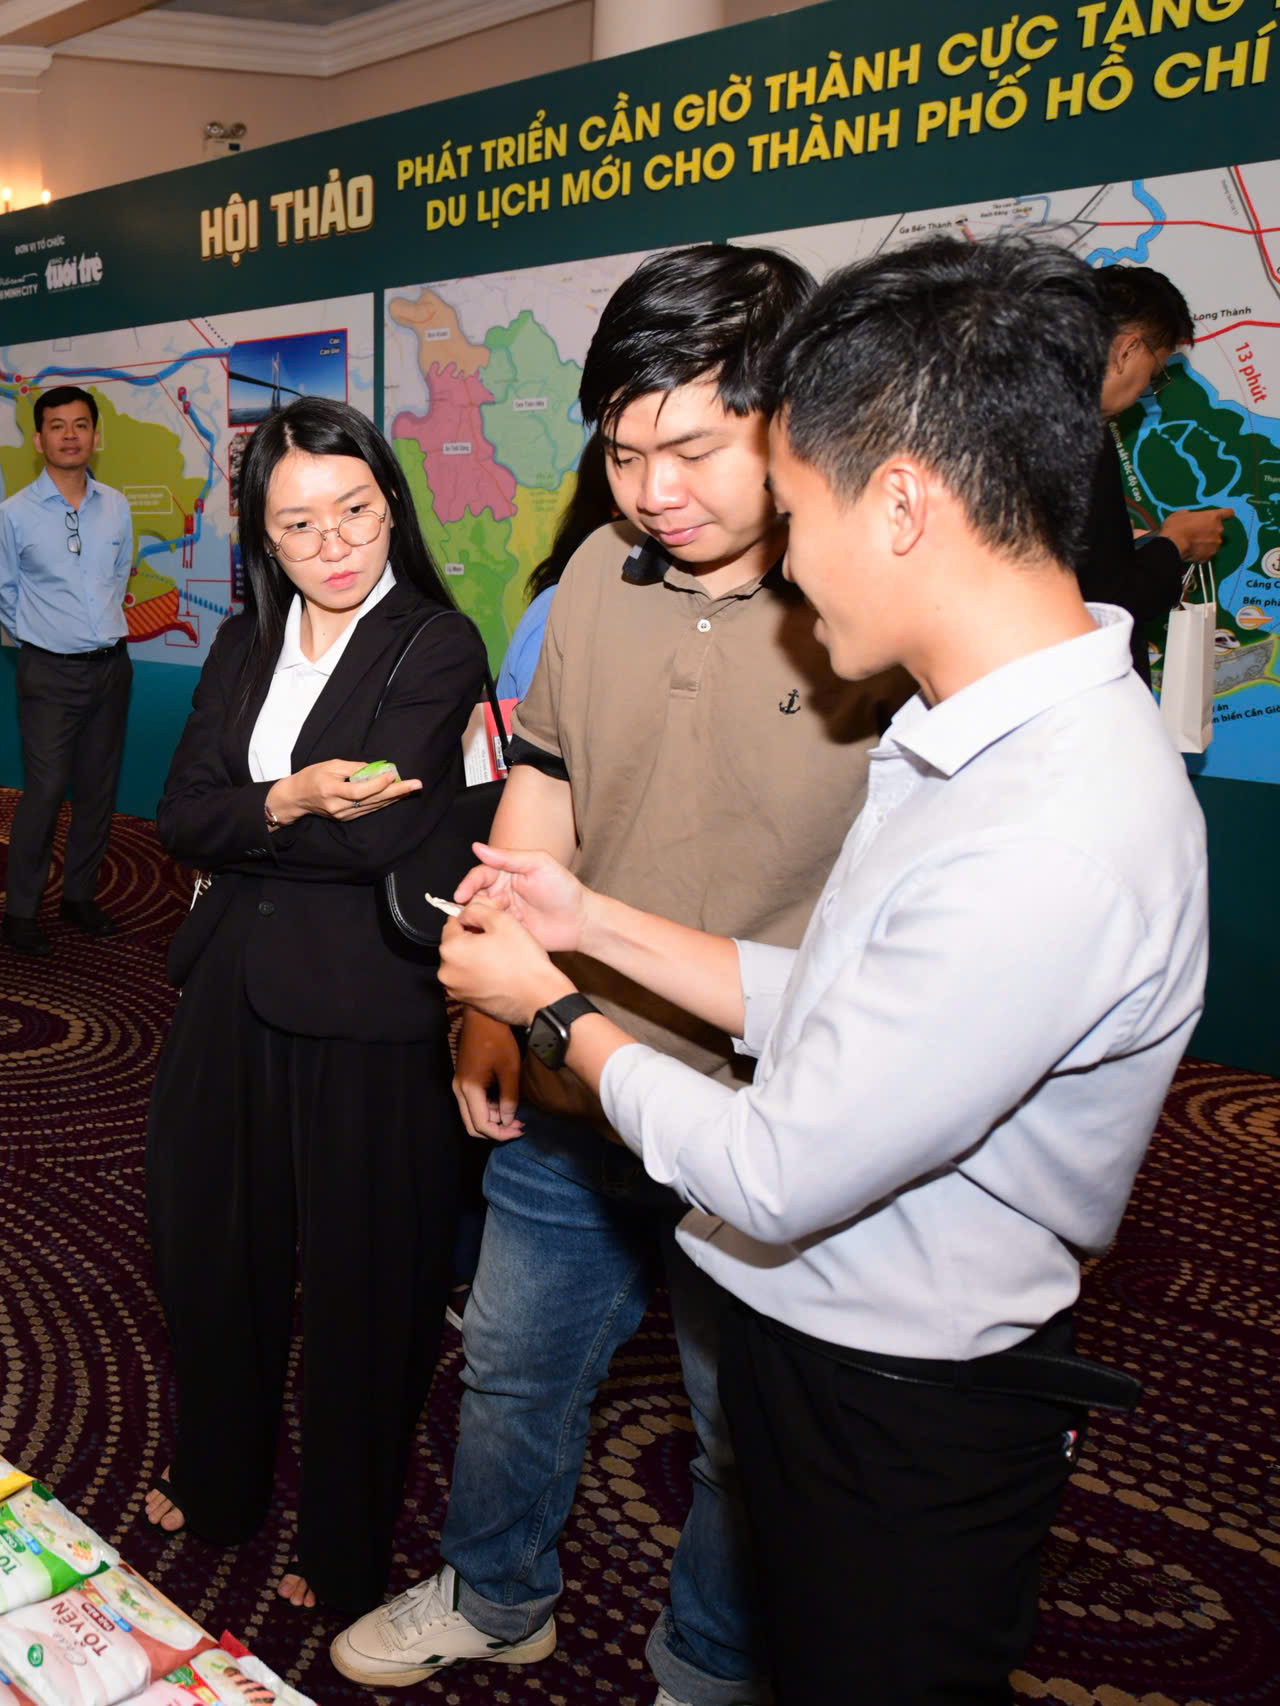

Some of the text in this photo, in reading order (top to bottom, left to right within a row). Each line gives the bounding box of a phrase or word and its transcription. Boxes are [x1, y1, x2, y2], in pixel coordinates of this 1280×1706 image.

[397, 15, 1059, 191] PHÁT TRIỂN CẦN GIỜ THÀNH CỰC
[426, 21, 1278, 233] DU LỊCH MỚI CHO THÀNH PHỐ HỒ CHÍ
[200, 168, 374, 267] HỘI THẢO
[899, 226, 910, 235] Ga
[927, 220, 953, 231] Thành
[22, 284, 38, 296] CITY
[1193, 306, 1252, 321] Long Thành
[1236, 341, 1268, 404] 13 phút
[1132, 487, 1142, 501] cao
[51, 1601, 85, 1634] YẾN
[74, 1632, 108, 1657] TỔ
